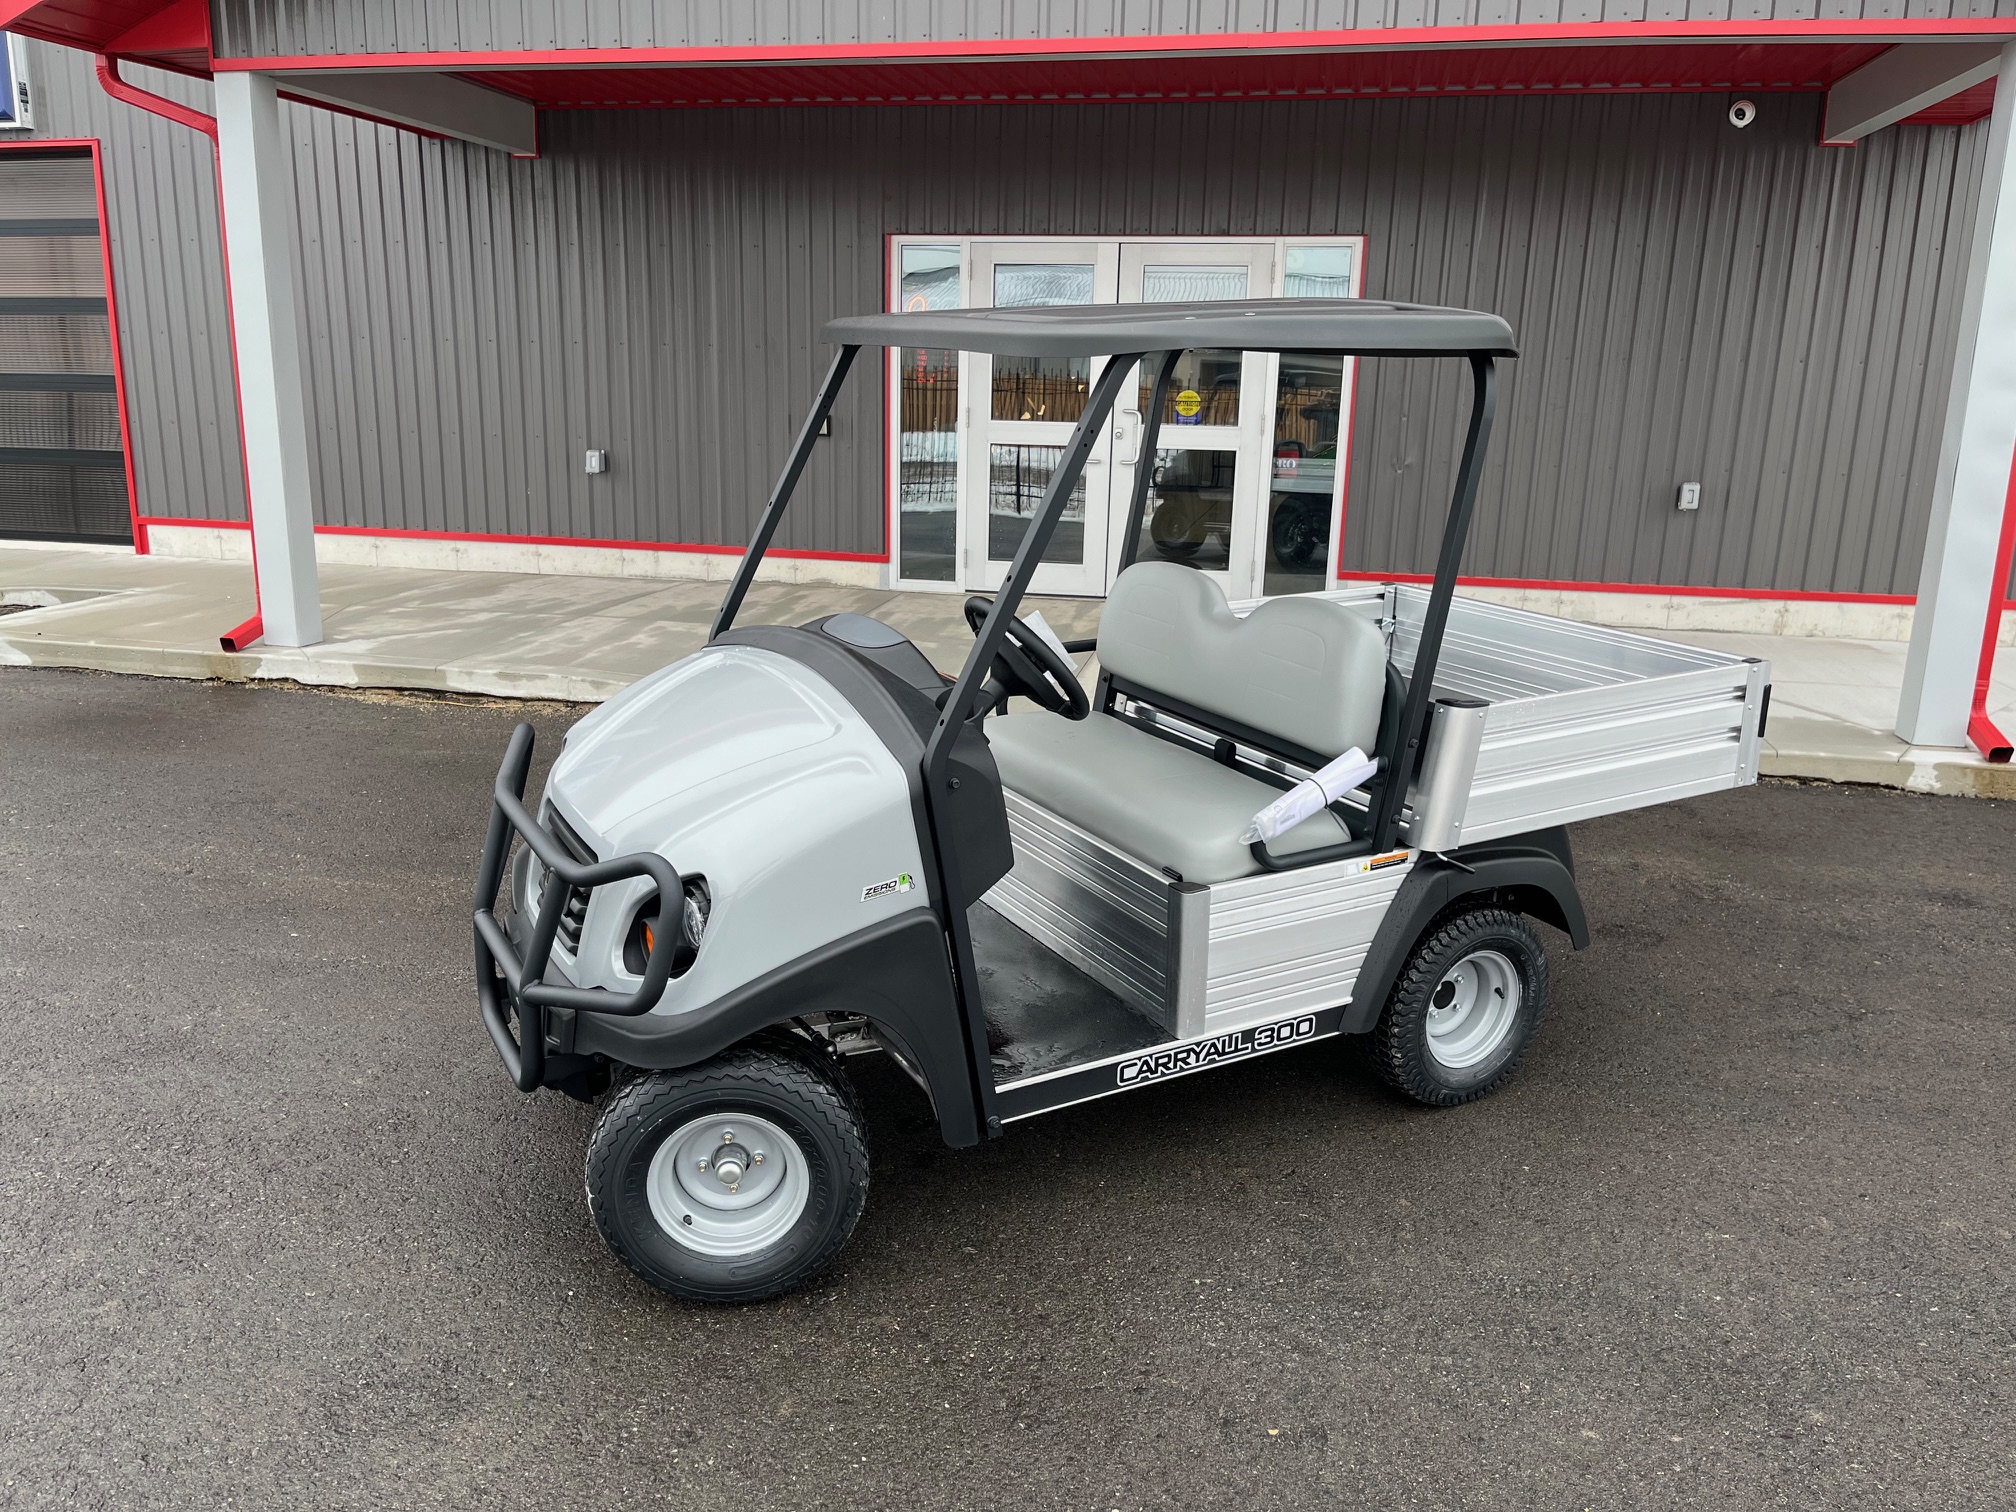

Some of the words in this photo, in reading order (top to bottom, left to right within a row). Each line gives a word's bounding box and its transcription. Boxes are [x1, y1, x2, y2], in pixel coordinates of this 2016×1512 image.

[864, 880, 898, 896] ZERO
[1117, 1033, 1251, 1086] CARRYALL
[1254, 1014, 1316, 1050] 300
[625, 1161, 653, 1241] KENDA
